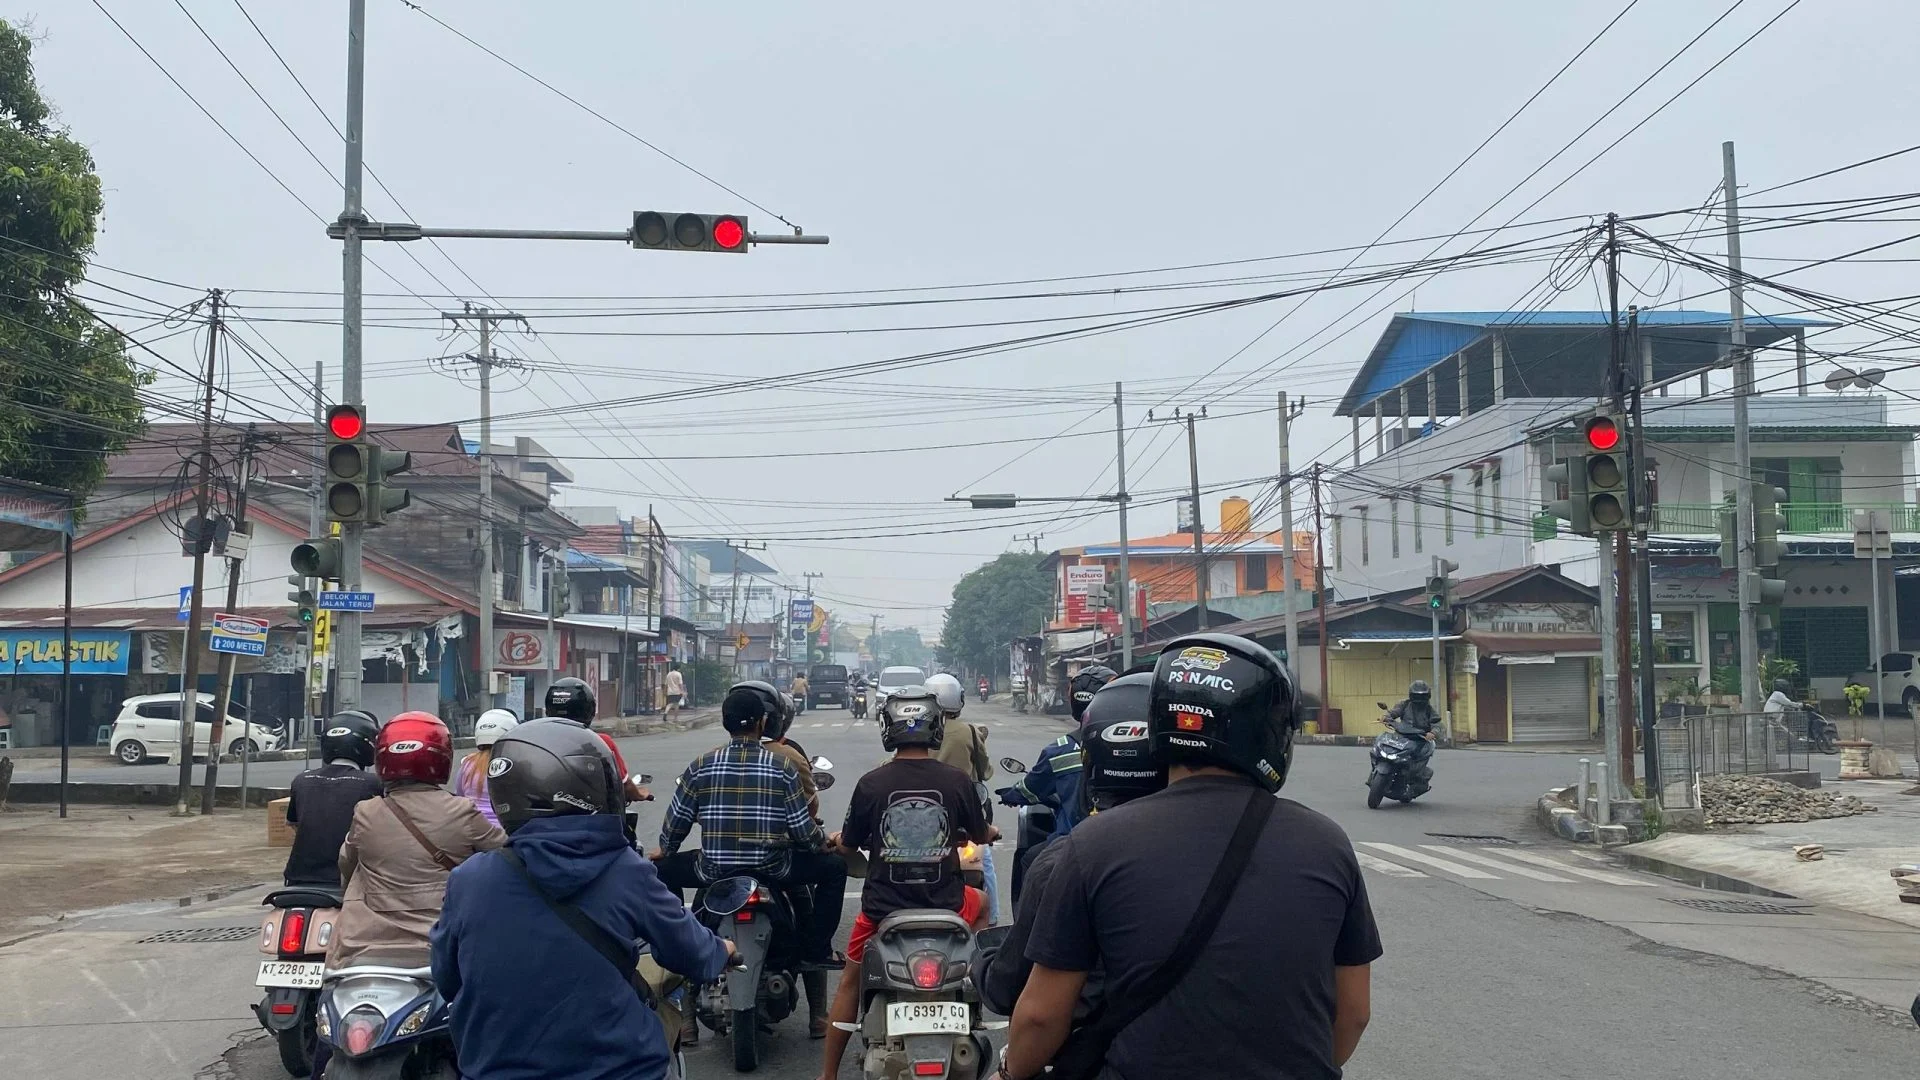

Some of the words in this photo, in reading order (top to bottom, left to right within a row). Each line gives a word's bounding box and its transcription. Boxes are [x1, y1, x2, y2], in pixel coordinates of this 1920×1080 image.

[324, 593, 350, 601] BELOK
[1537, 622, 1568, 632] AGENCY
[15, 639, 119, 662] PLASTIK
[222, 639, 235, 649] 200
[236, 641, 263, 652] METER
[1168, 703, 1215, 718] HONDA
[1112, 726, 1147, 737] GM
[395, 743, 417, 751] GM
[1169, 736, 1208, 748] HONDA
[880, 846, 952, 857] PASUKAN
[262, 963, 275, 975] KT
[277, 964, 305, 975] 2280
[310, 965, 322, 976] JL
[894, 1005, 909, 1020] KT
[913, 1005, 944, 1018] 6397
